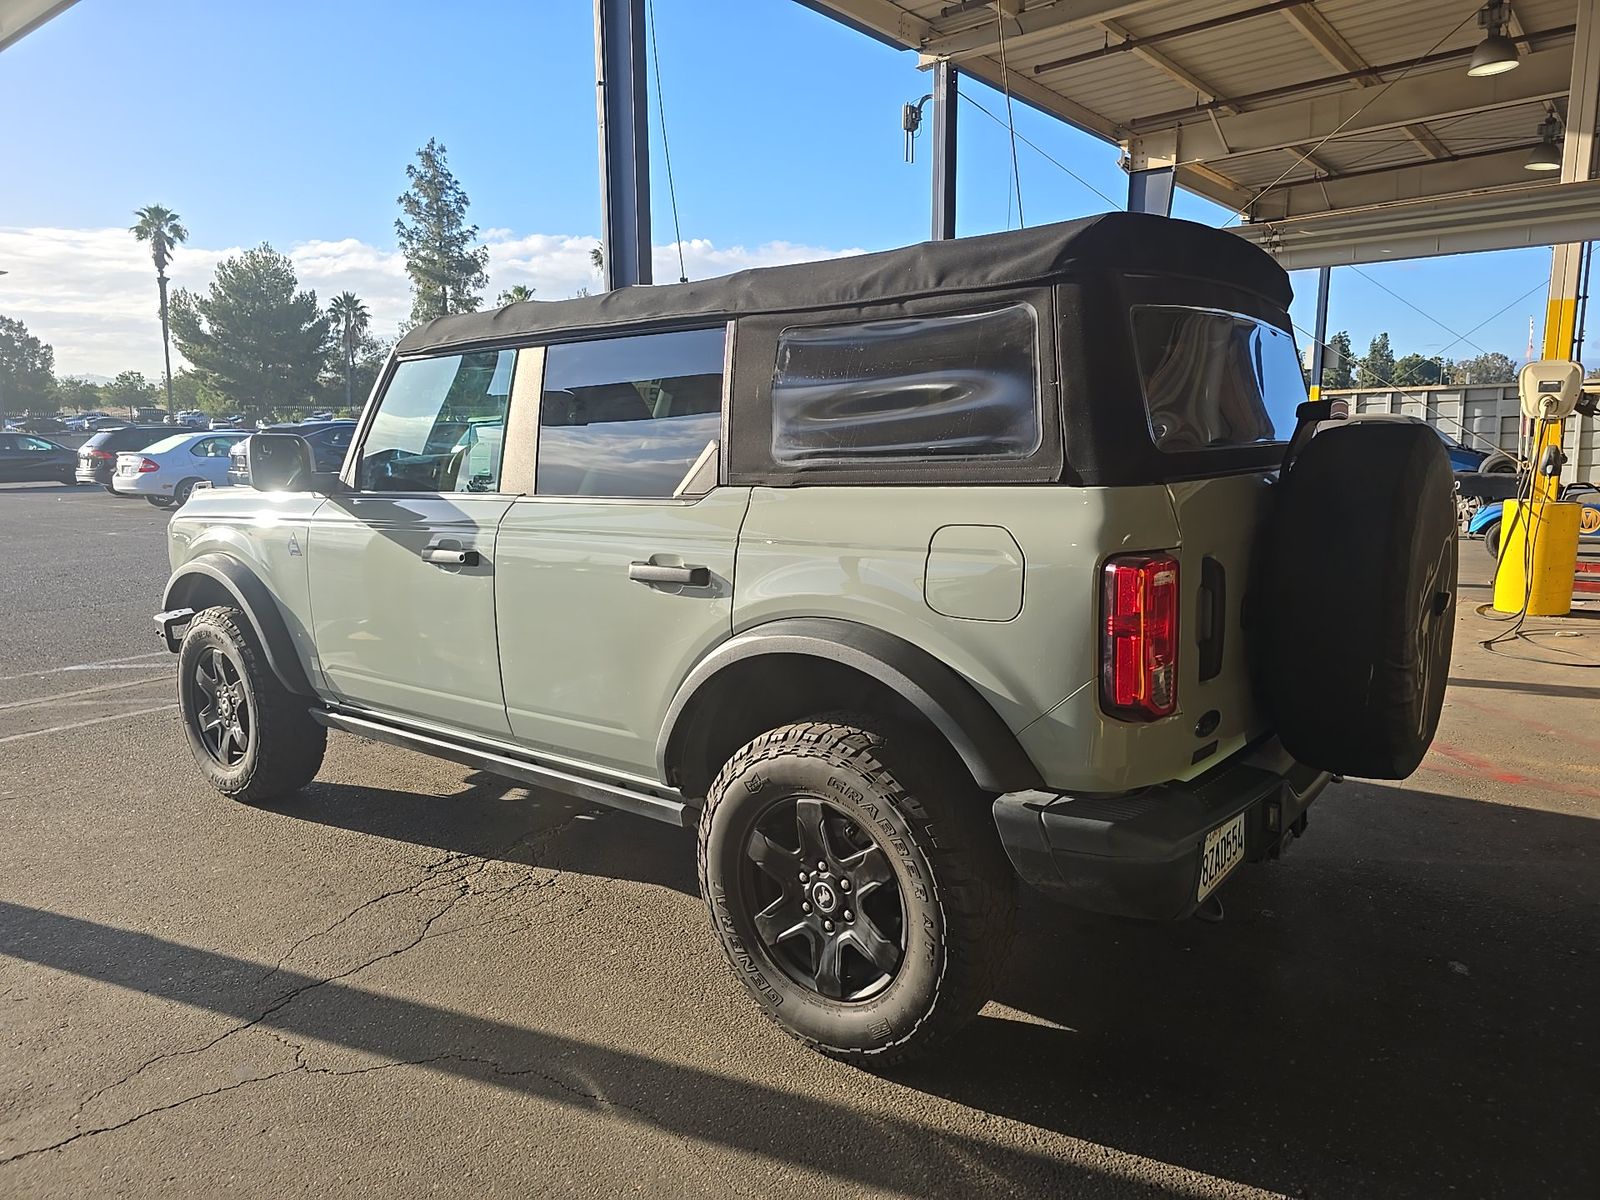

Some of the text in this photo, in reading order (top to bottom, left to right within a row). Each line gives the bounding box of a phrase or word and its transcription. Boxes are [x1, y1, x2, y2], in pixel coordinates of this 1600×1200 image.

[827, 776, 929, 903] GRABBER
[1202, 820, 1244, 887] 8ZAD554
[713, 876, 784, 1007] GENERAL
